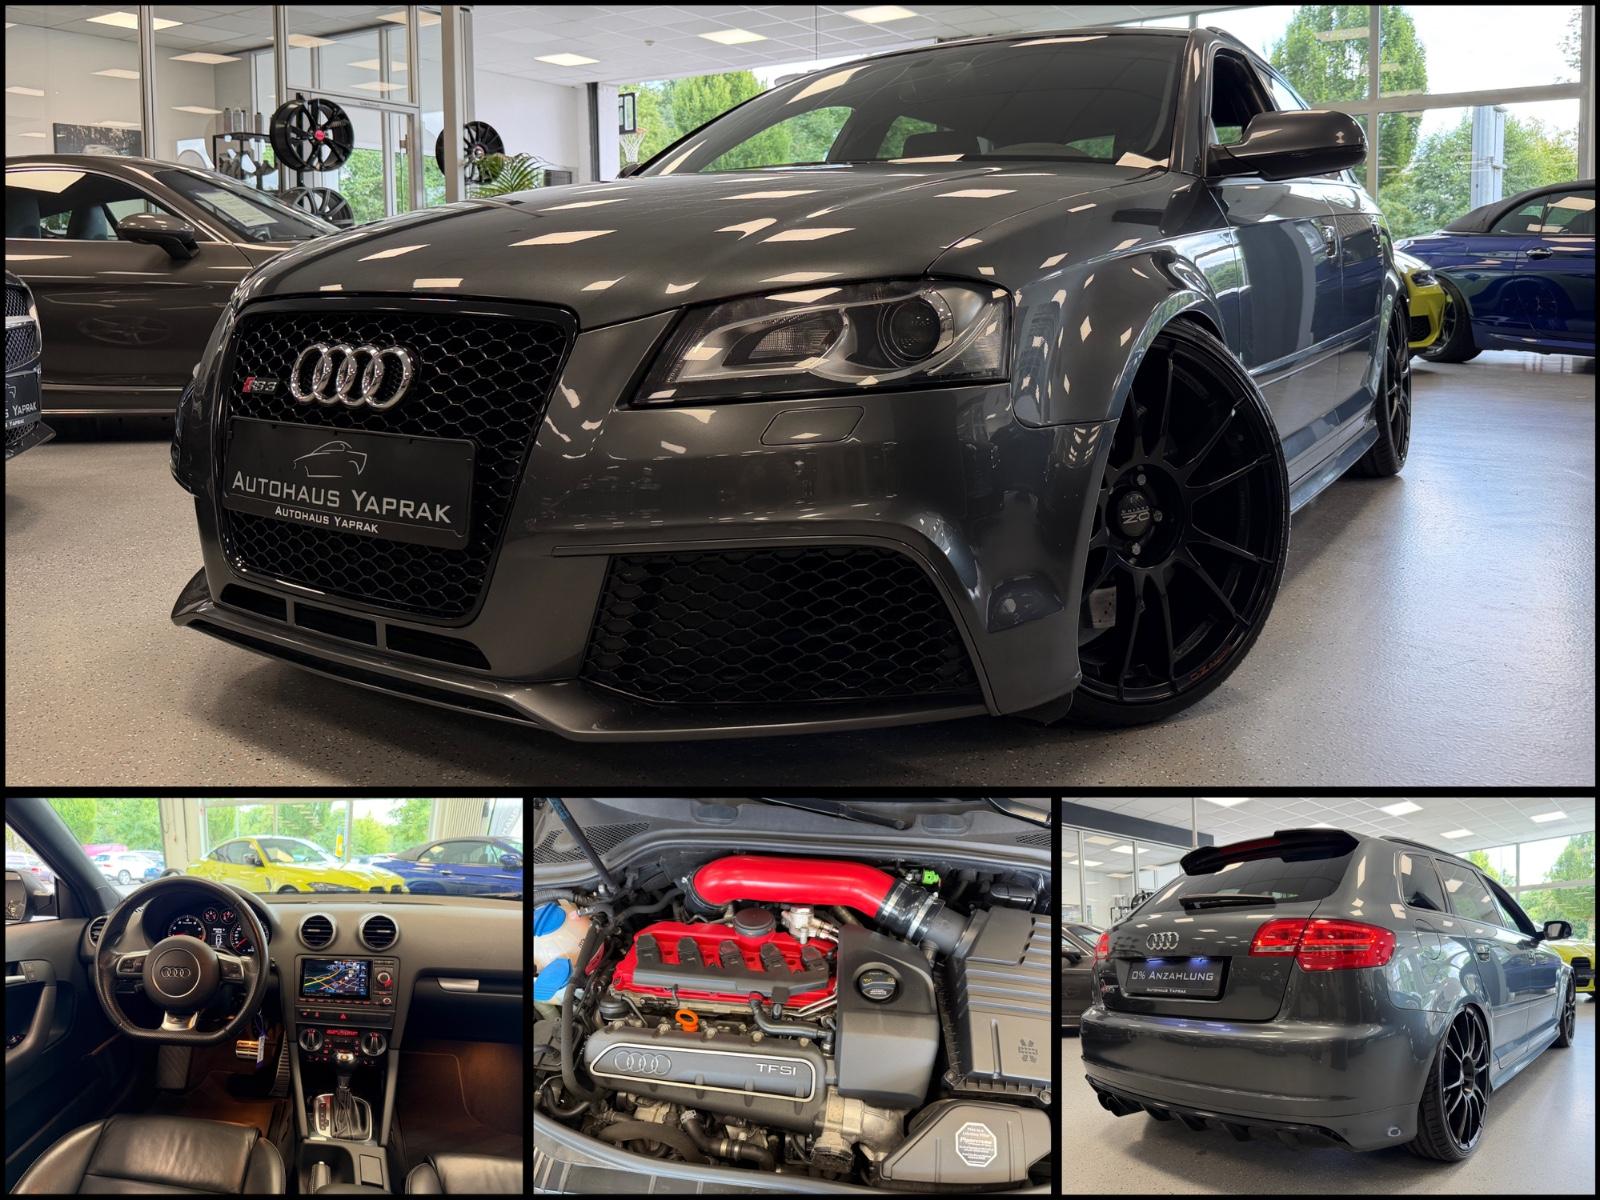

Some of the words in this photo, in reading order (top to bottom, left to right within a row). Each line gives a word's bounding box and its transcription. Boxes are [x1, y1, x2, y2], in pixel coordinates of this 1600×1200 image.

[12, 401, 37, 416] YAPRAK
[232, 471, 340, 507] AUTOHAUS
[351, 489, 452, 523] YAPRAK
[275, 506, 330, 525] AUTOHAUS
[334, 516, 378, 533] YAPRAK
[1131, 971, 1146, 980] 0%
[1148, 971, 1214, 981] ANZAHLUNG
[756, 1063, 796, 1076] TFSI
